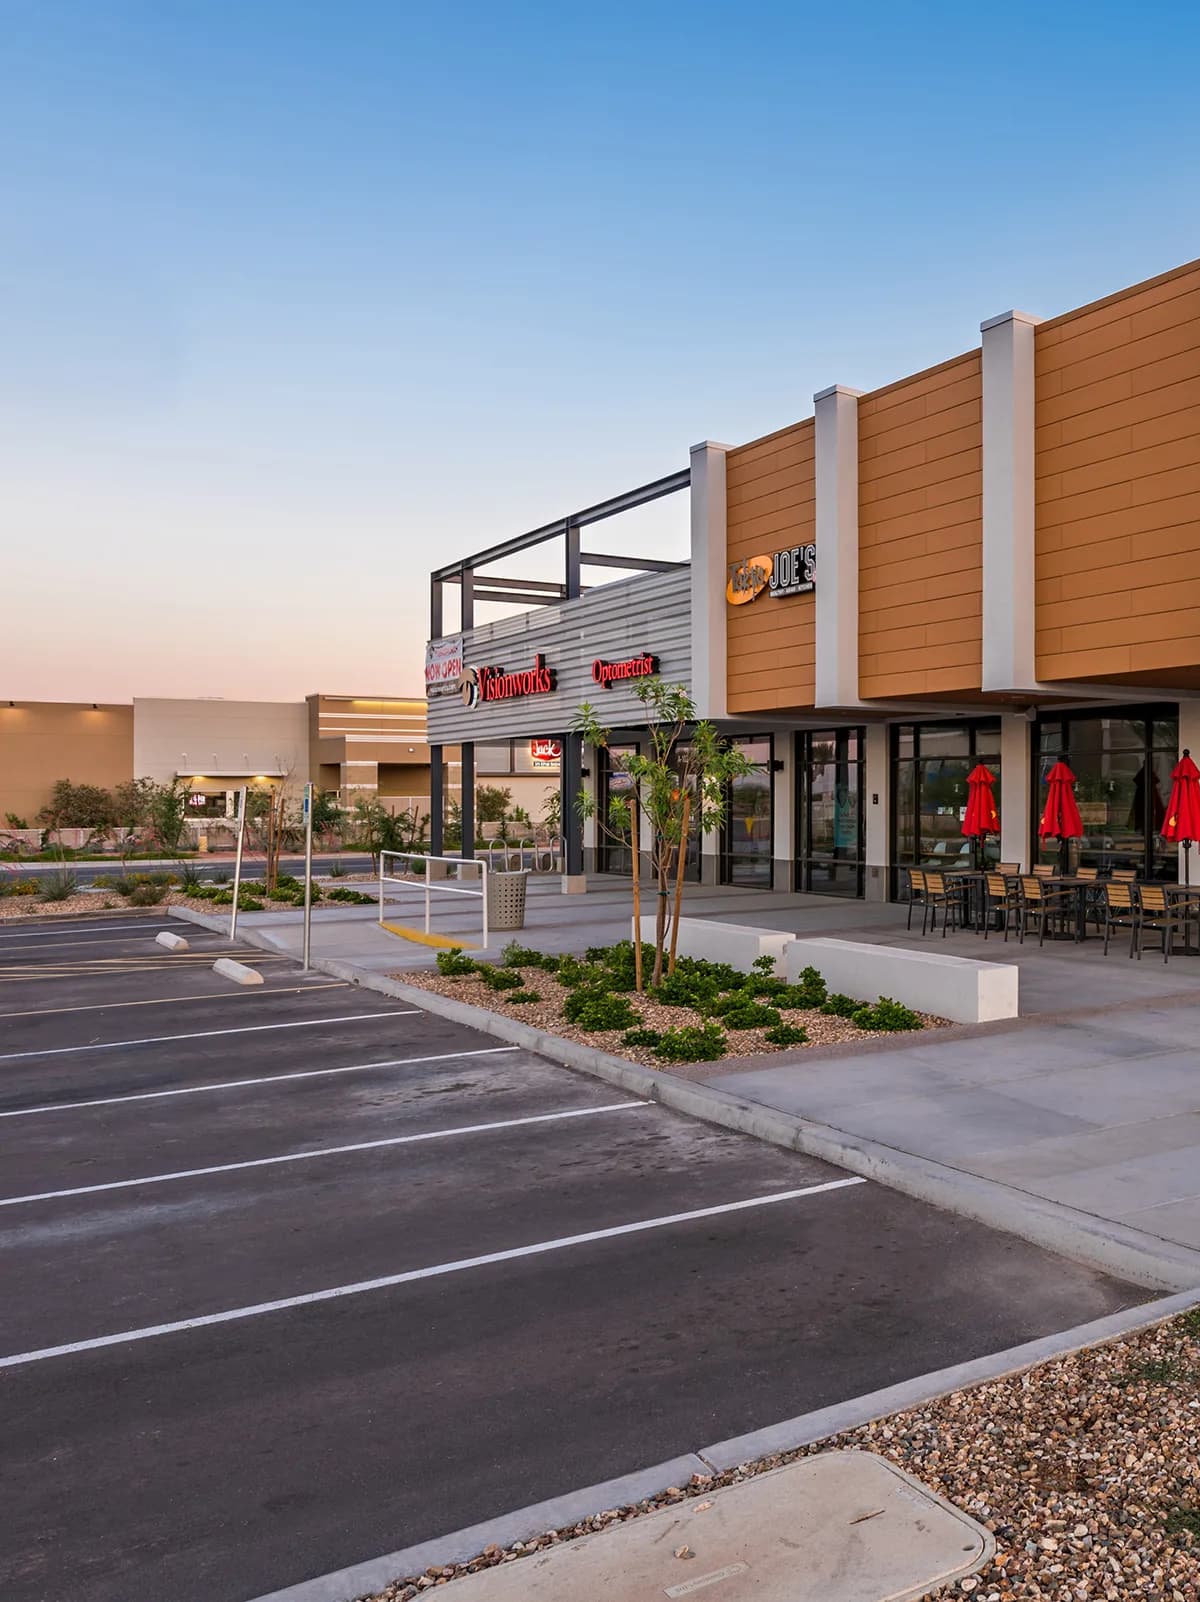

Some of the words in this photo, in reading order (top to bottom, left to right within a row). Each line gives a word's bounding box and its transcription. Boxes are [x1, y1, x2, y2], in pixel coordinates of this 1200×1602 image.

[769, 544, 816, 590] JOE'S
[425, 663, 441, 681] NOW
[442, 657, 461, 679] OPEN
[477, 653, 553, 702] Visionworks
[592, 652, 656, 688] Optometrist
[533, 739, 561, 757] Jack
